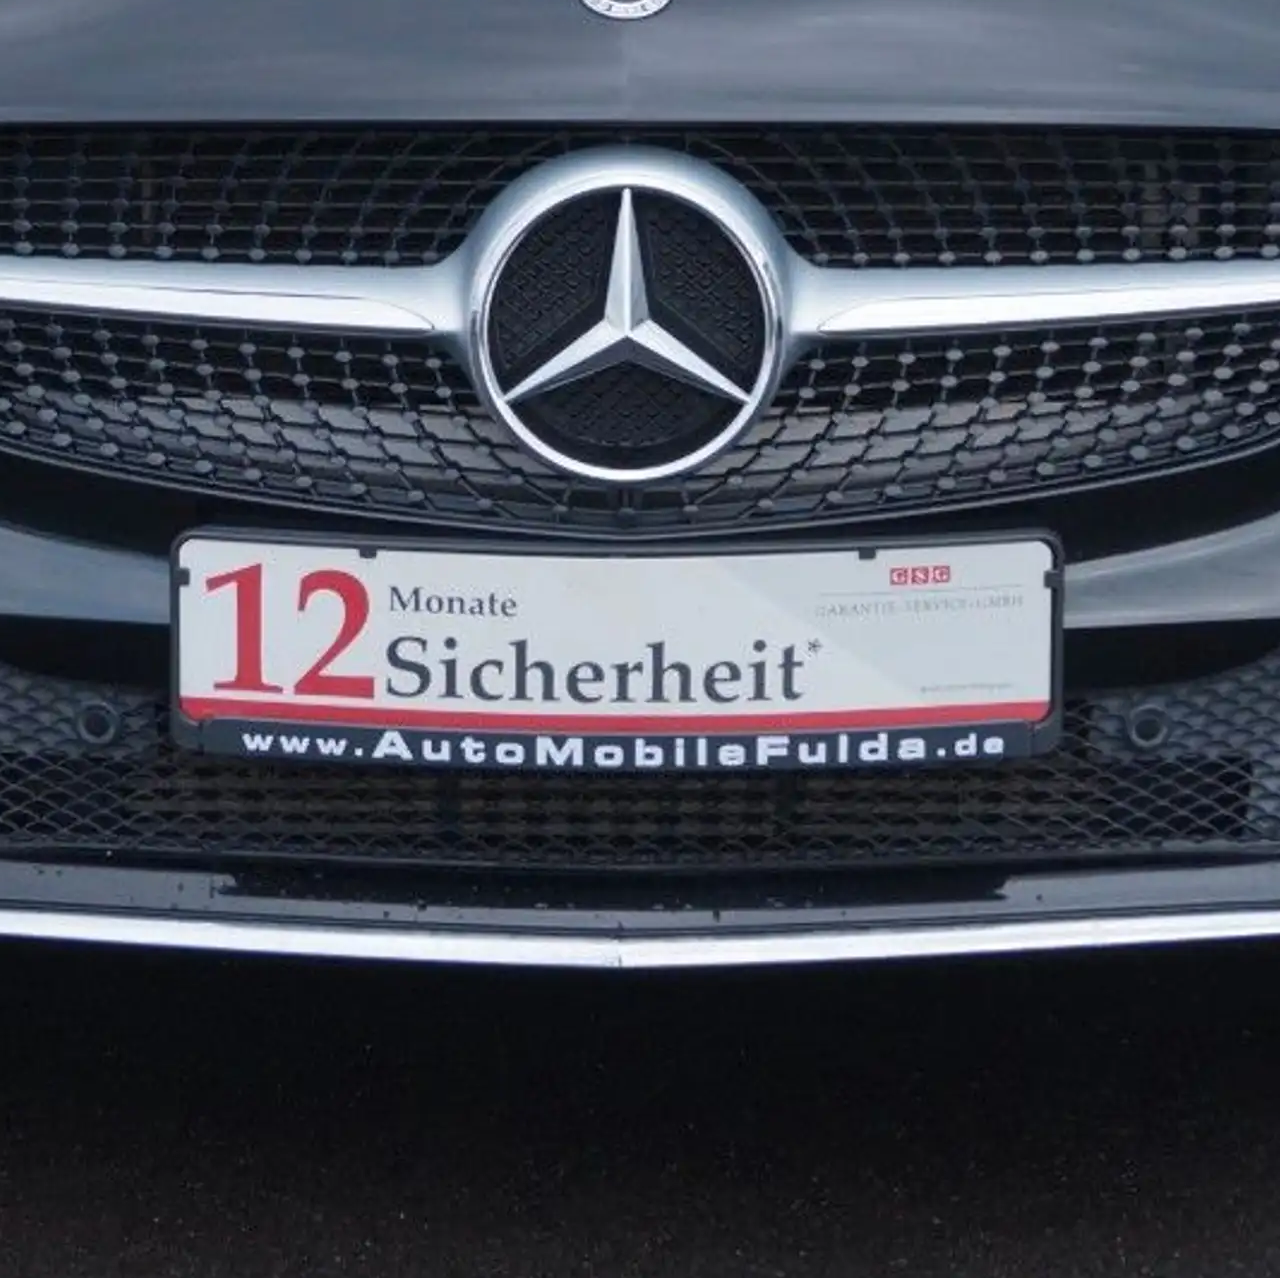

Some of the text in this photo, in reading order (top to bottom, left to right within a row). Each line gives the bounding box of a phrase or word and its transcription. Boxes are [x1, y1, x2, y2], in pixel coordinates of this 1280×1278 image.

[388, 585, 518, 618] Monate
[205, 562, 376, 699] 12
[241, 730, 1007, 768] www.AutoMobileFulda.de
